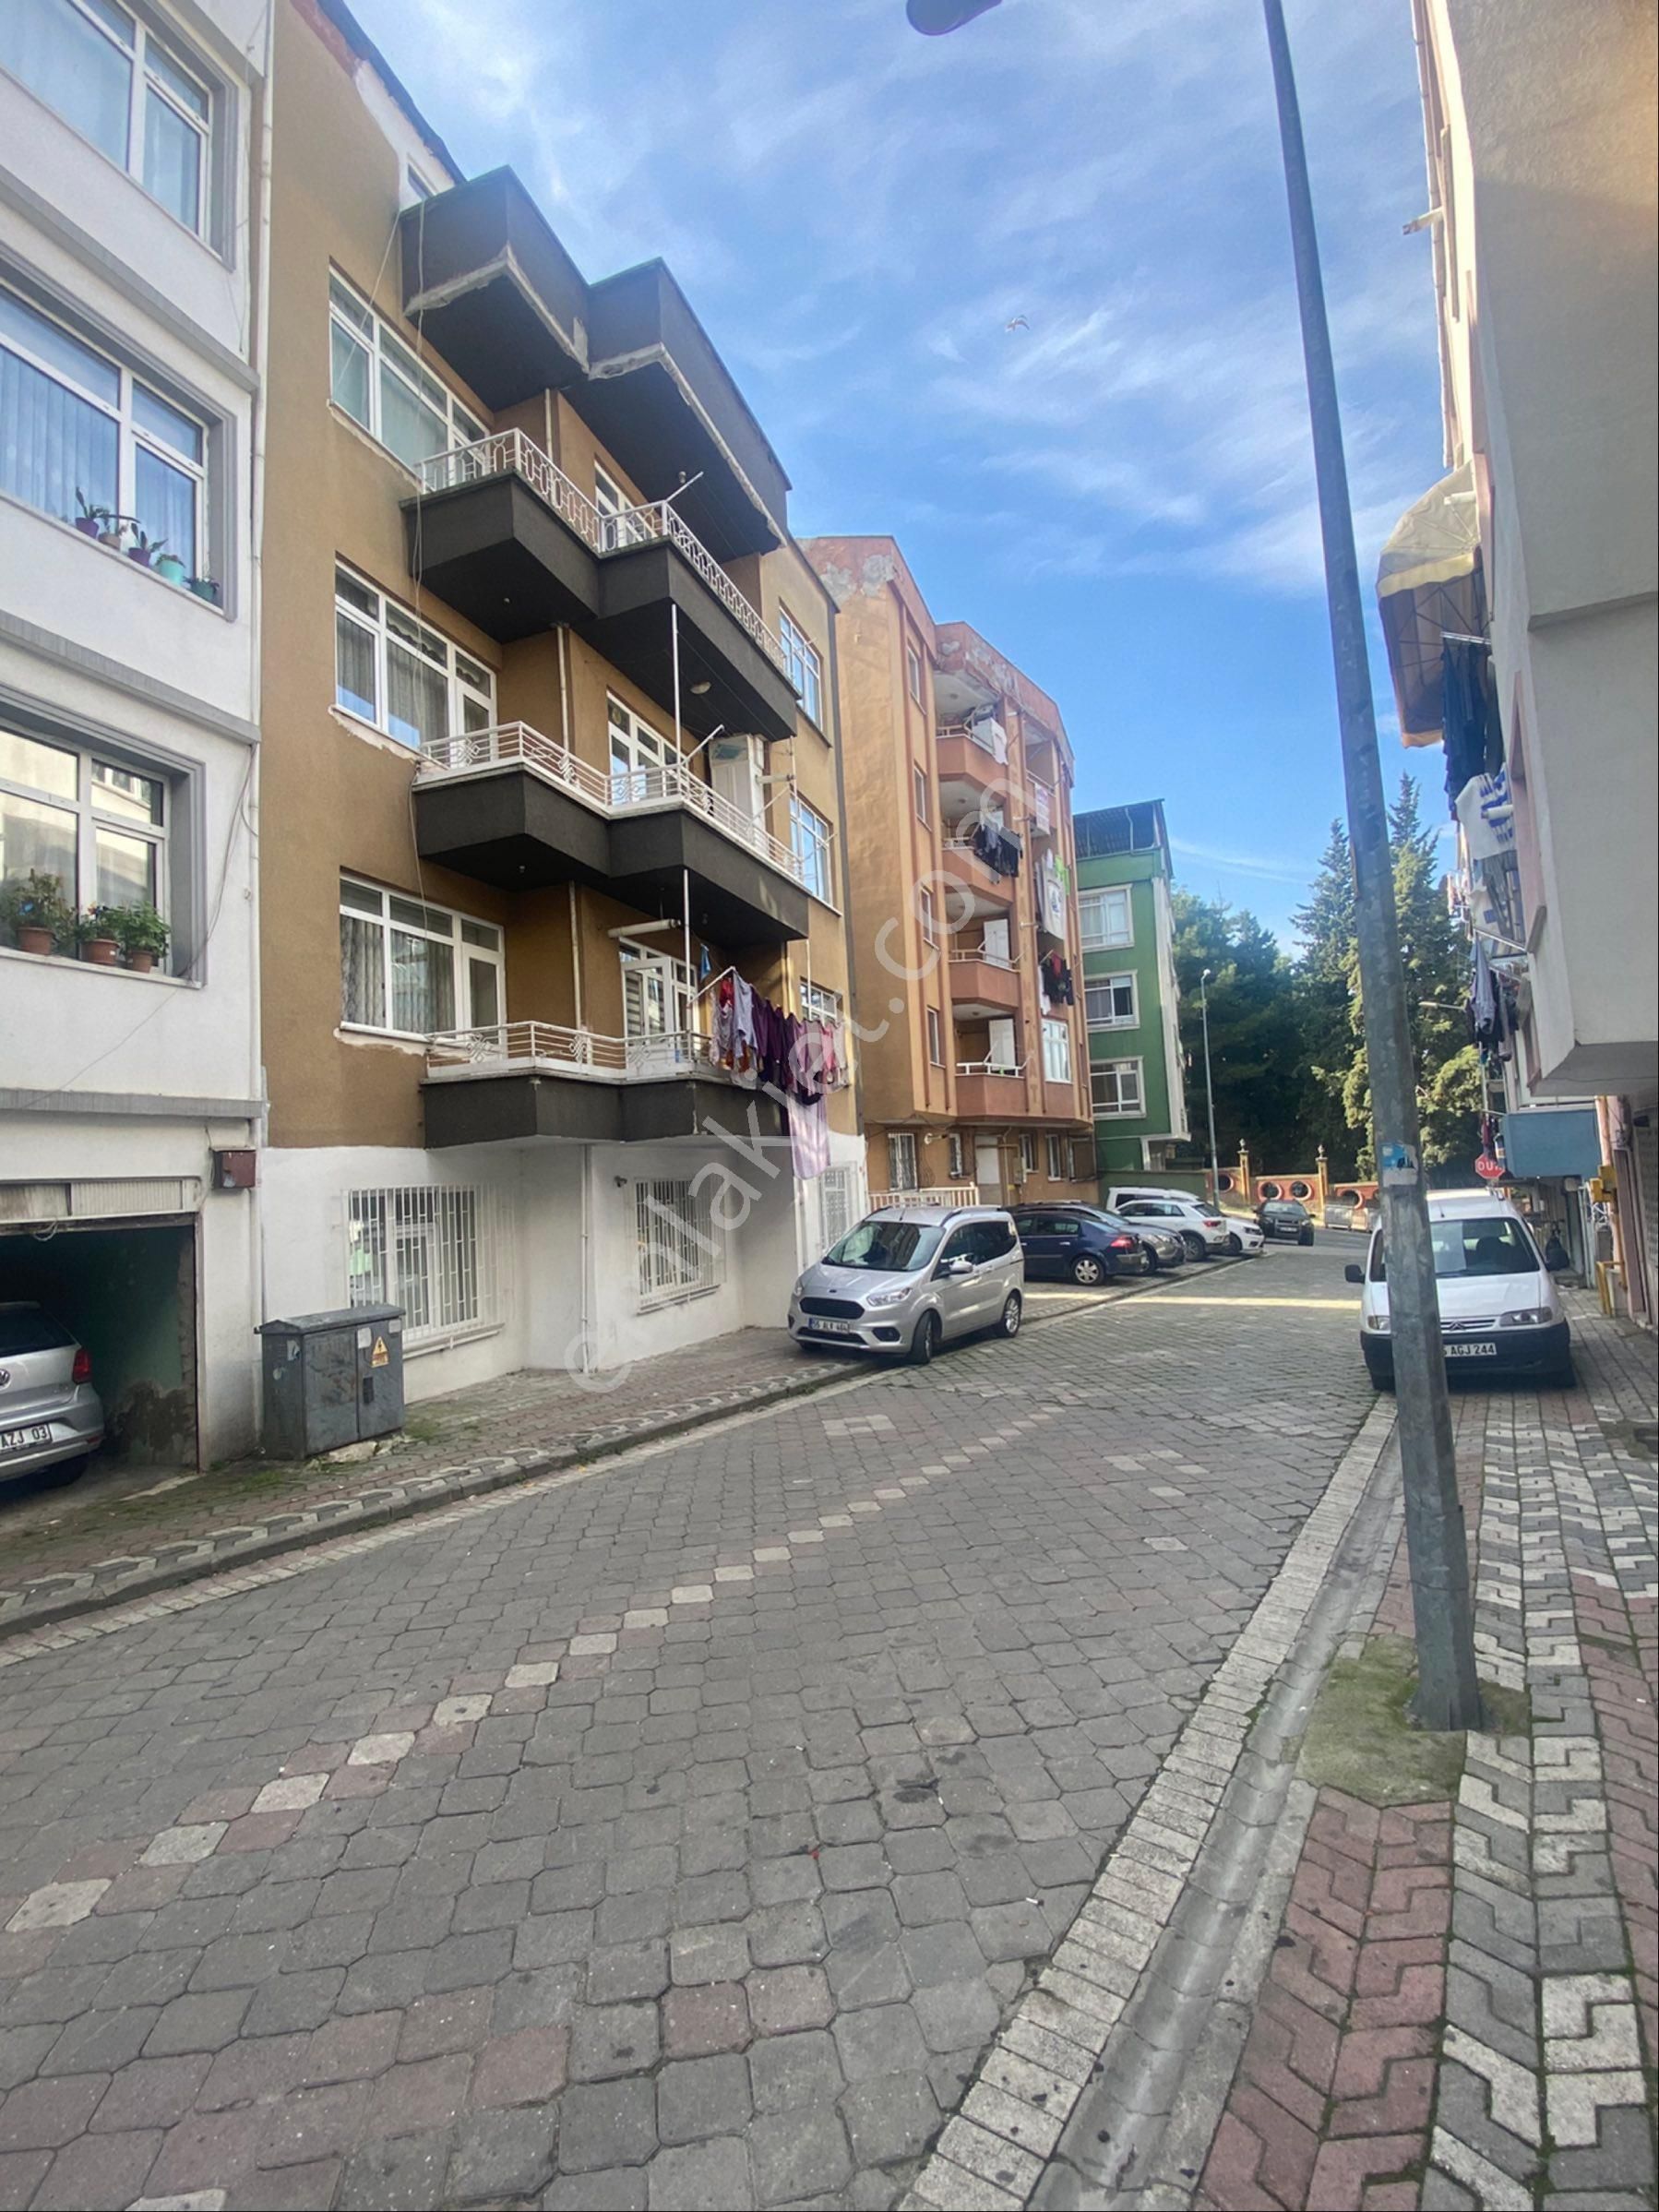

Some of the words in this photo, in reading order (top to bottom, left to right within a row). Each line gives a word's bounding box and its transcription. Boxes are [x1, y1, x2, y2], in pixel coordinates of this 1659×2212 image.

[1450, 1345, 1471, 1355] AGJ
[1474, 1344, 1495, 1354] 244
[1, 1430, 24, 1448] AZJ
[31, 1426, 47, 1441] 03
